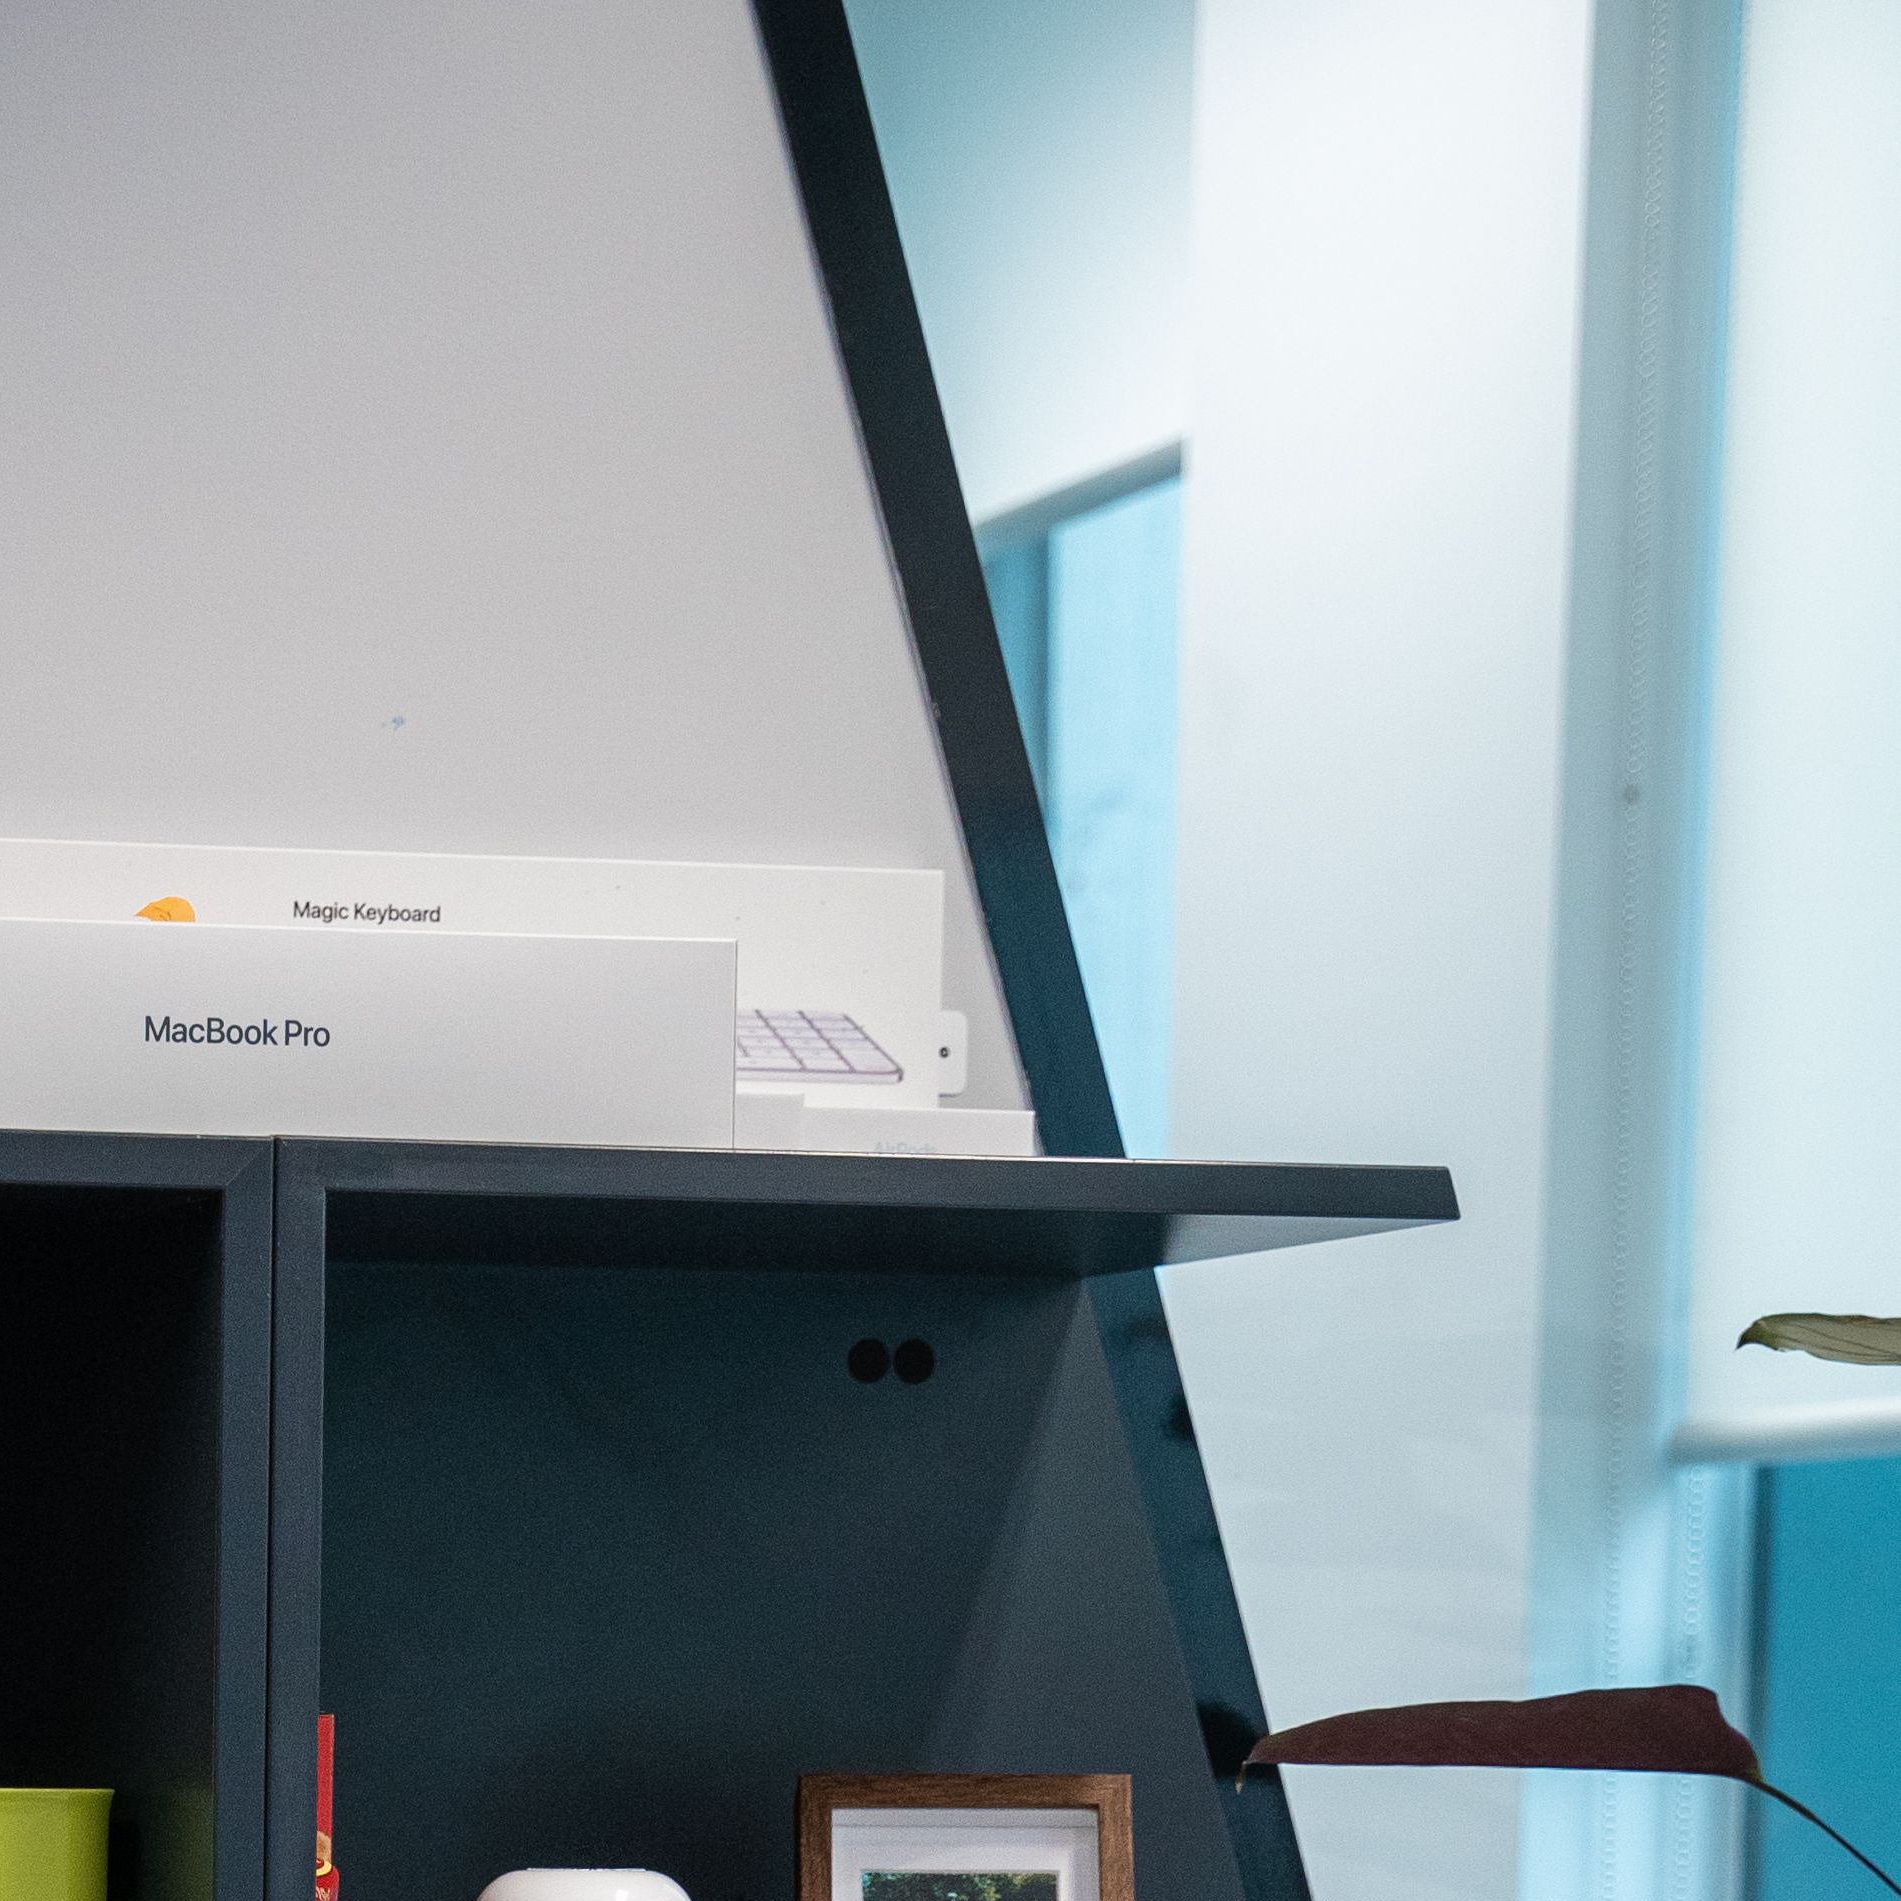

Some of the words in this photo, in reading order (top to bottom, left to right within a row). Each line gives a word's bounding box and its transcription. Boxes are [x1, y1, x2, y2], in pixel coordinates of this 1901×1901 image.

[292, 898, 347, 927] Magic
[352, 901, 442, 929] Keyboard
[143, 1013, 279, 1047] MacBook
[283, 1019, 331, 1049] Pro
